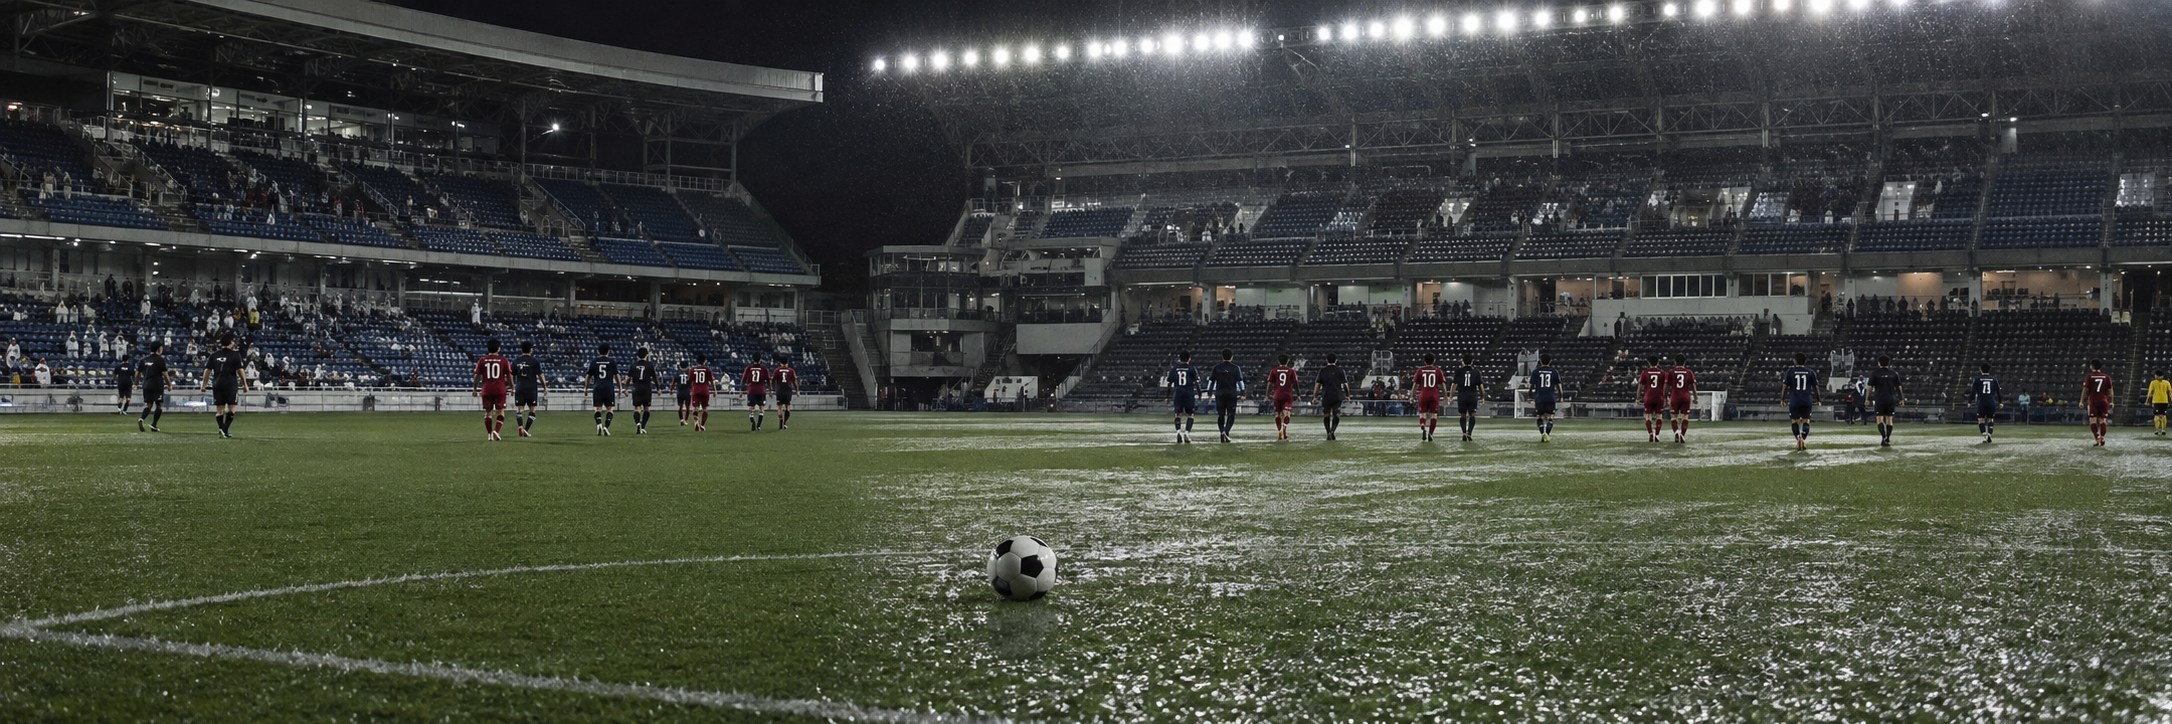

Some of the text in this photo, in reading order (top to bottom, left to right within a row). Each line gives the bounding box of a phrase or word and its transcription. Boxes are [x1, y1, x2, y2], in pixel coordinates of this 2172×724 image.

[485, 362, 500, 379] 10
[598, 364, 607, 379] 5
[1279, 373, 1287, 386] 9
[1422, 373, 1436, 388] 10
[1650, 375, 1658, 388] 3
[1677, 374, 1684, 388] 3
[1794, 374, 1807, 390] 11
[2095, 379, 2103, 392] 7
